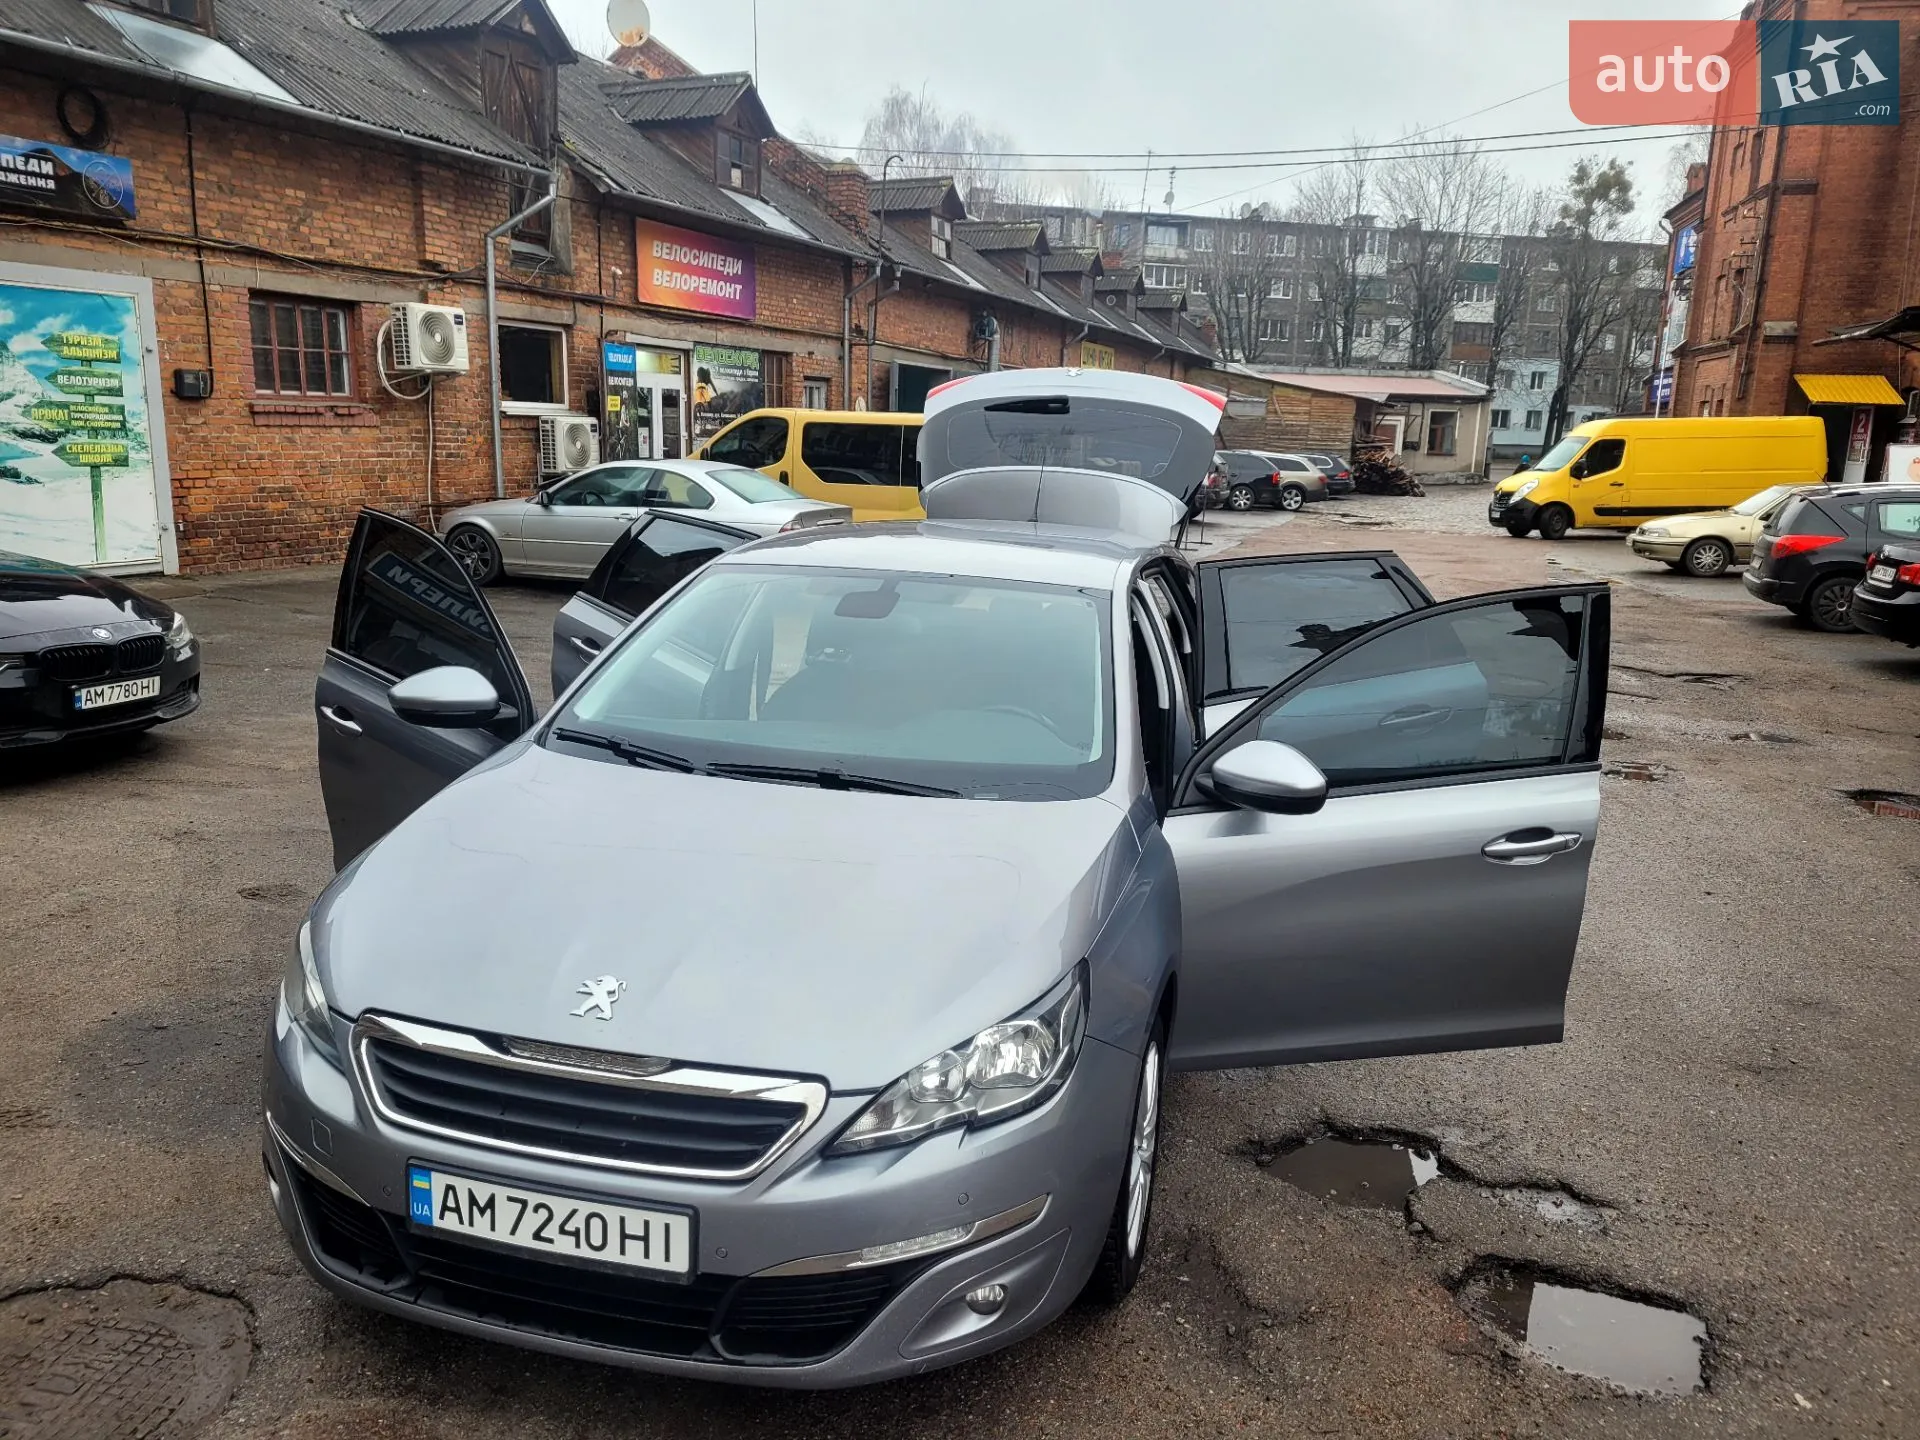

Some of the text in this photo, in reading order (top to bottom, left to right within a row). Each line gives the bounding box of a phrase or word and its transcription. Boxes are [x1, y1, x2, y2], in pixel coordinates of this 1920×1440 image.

[652, 239, 743, 277] ВЕЛОСИПЕДИ
[652, 268, 743, 300] ВЕЛОРЕМОНТ
[62, 332, 105, 348] ТУРИЗМ,
[62, 346, 117, 360] АЛЬПІНІЗМ
[57, 374, 119, 388] ВЕЛОТУРИЗМ
[31, 407, 69, 421] ПРОКАТ
[79, 454, 113, 463] ШКОЛА
[413, 1202, 431, 1217] UA
